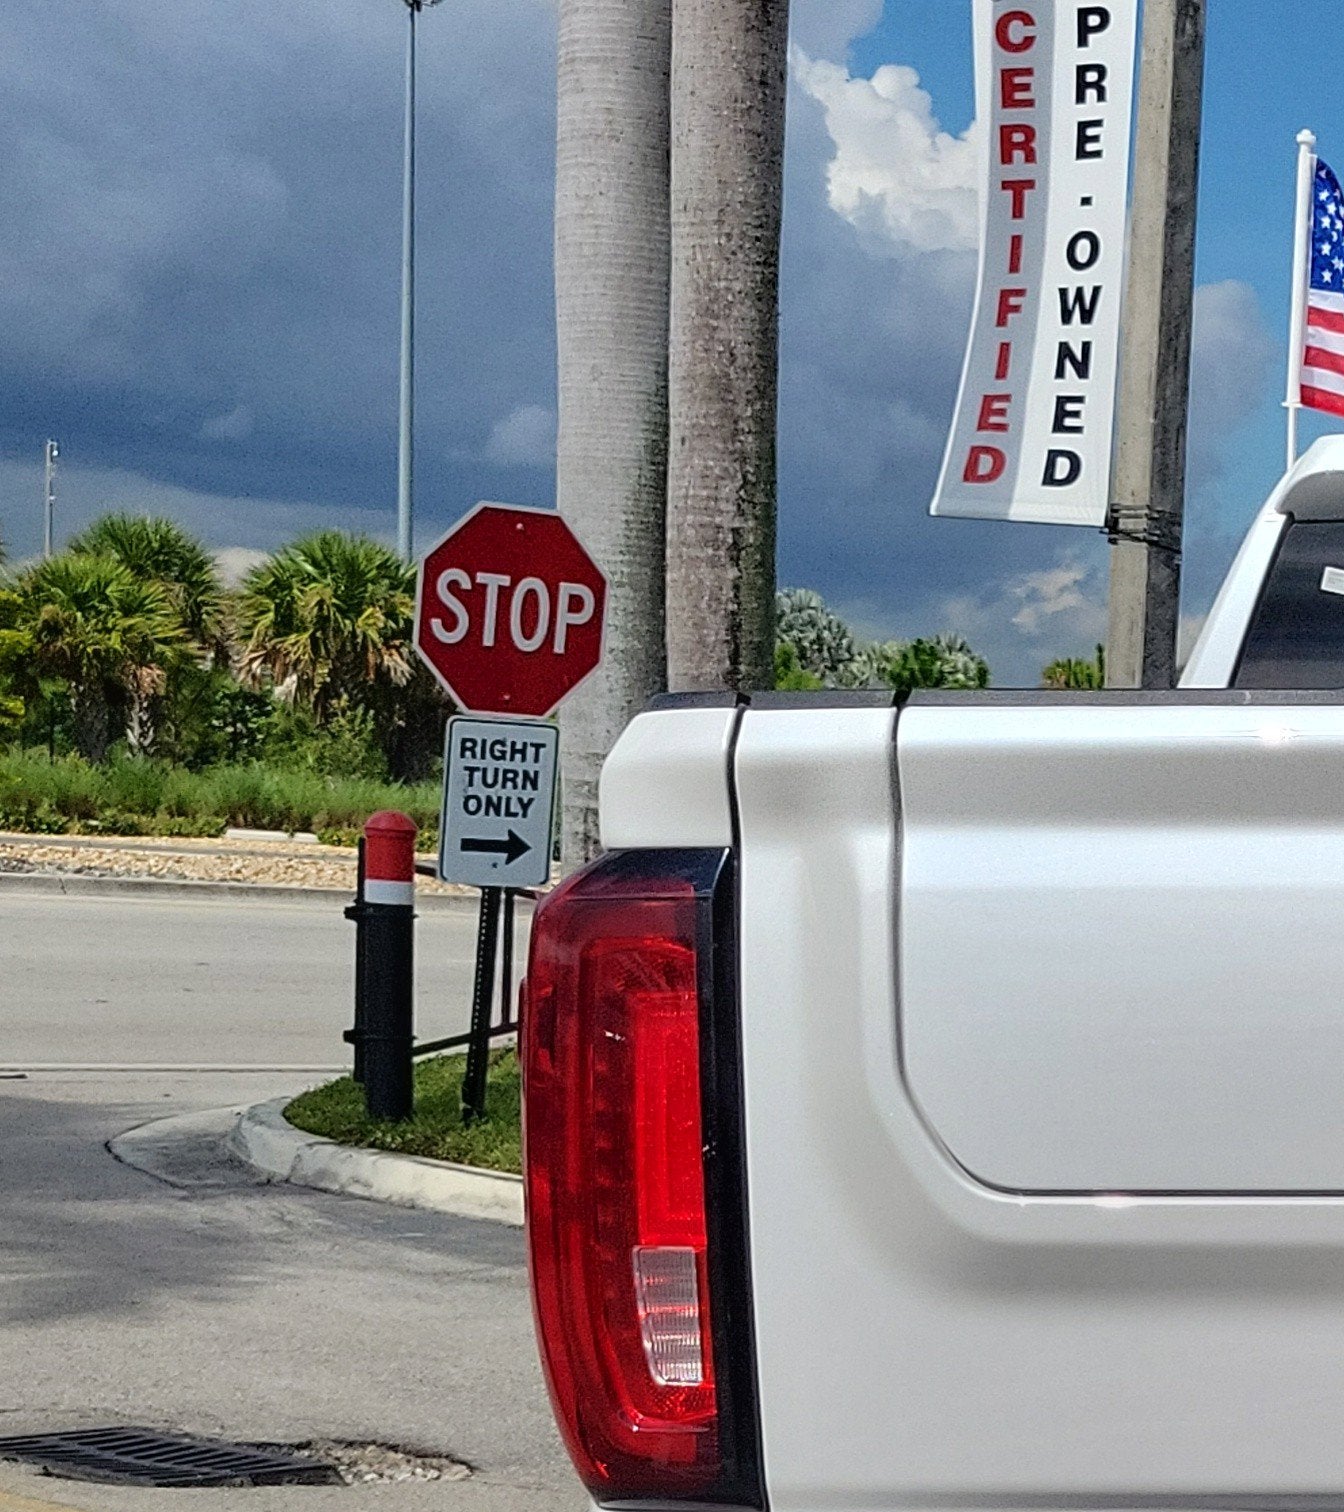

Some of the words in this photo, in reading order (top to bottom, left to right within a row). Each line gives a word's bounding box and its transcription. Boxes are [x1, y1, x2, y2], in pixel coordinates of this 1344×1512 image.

[962, 10, 1037, 485] CERTIFIED
[1041, 6, 1111, 488] PRE-OWNED
[430, 567, 596, 655] STOP
[459, 737, 546, 764] RIGHT
[464, 766, 539, 791] TURN
[462, 794, 535, 819] ONLY
